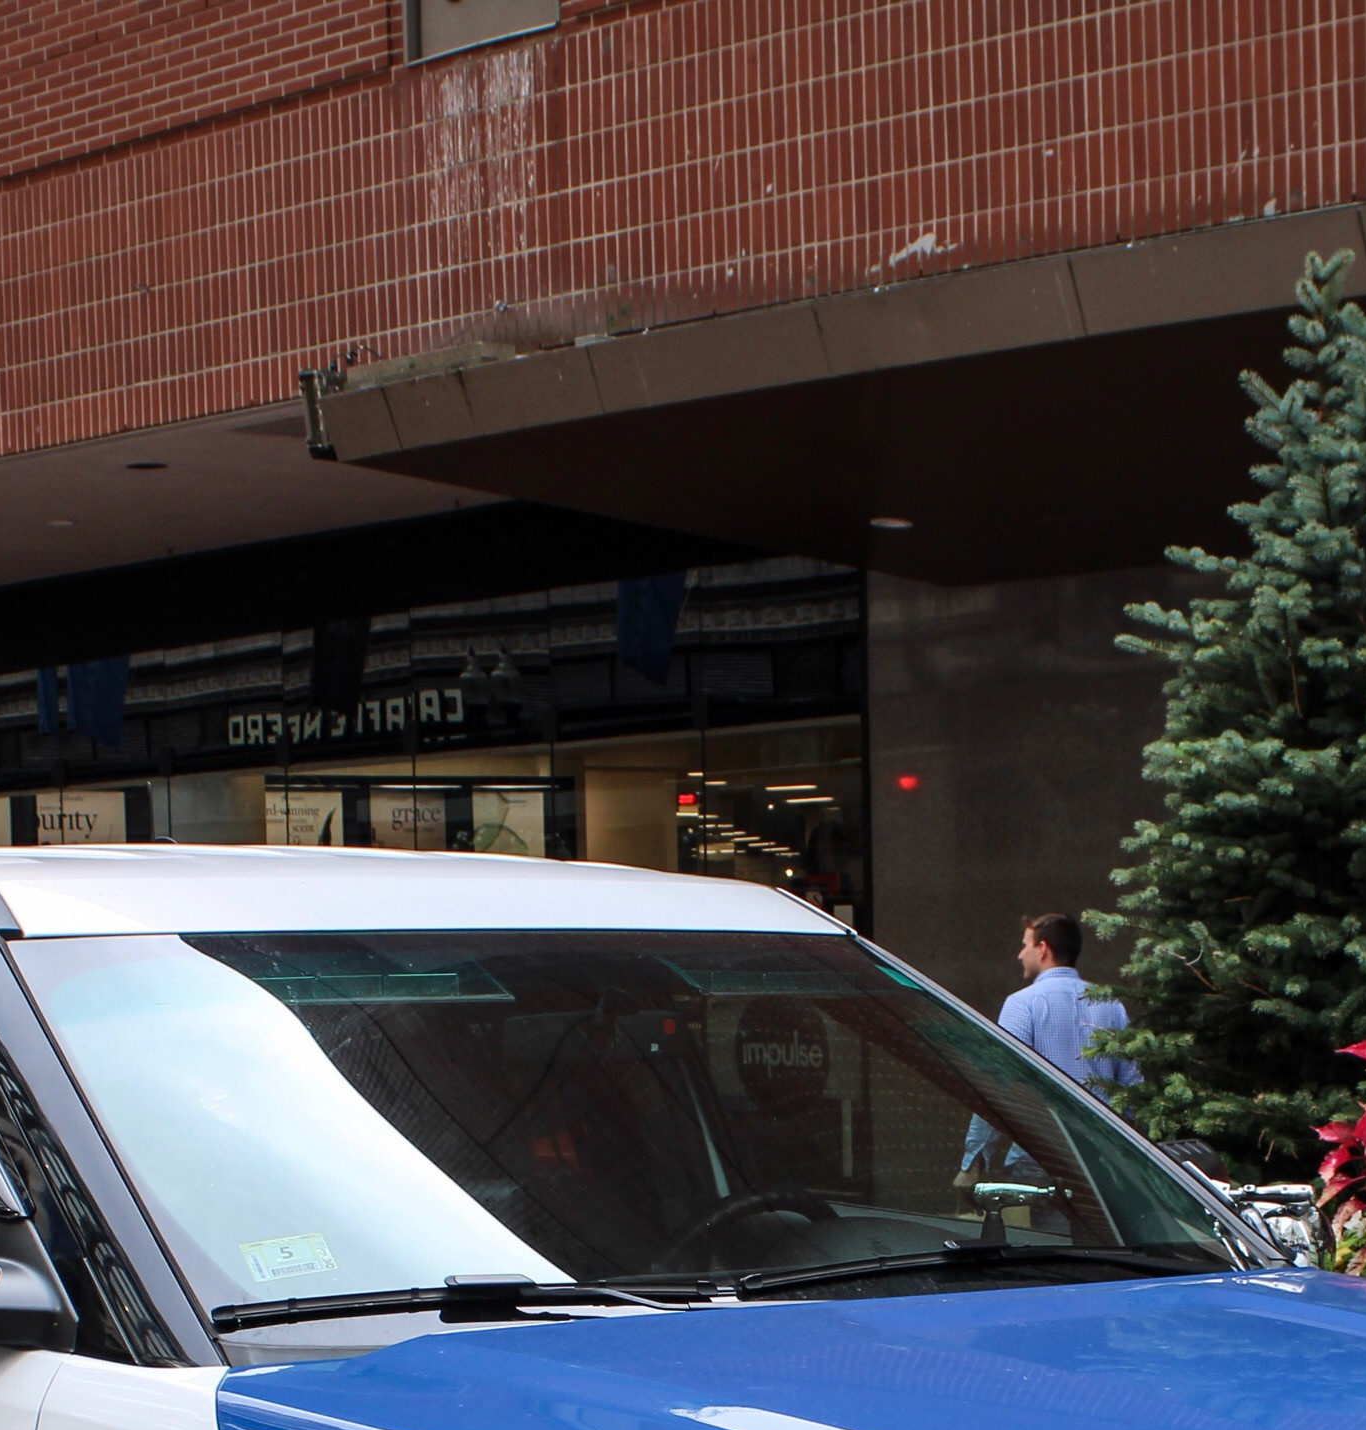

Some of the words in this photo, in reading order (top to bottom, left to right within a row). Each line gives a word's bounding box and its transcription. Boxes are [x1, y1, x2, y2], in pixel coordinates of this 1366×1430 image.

[36, 810, 97, 839] urity
[291, 823, 316, 833] scent
[392, 805, 441, 830] grace
[742, 1030, 823, 1078] impulse
[280, 1246, 294, 1260] 5
